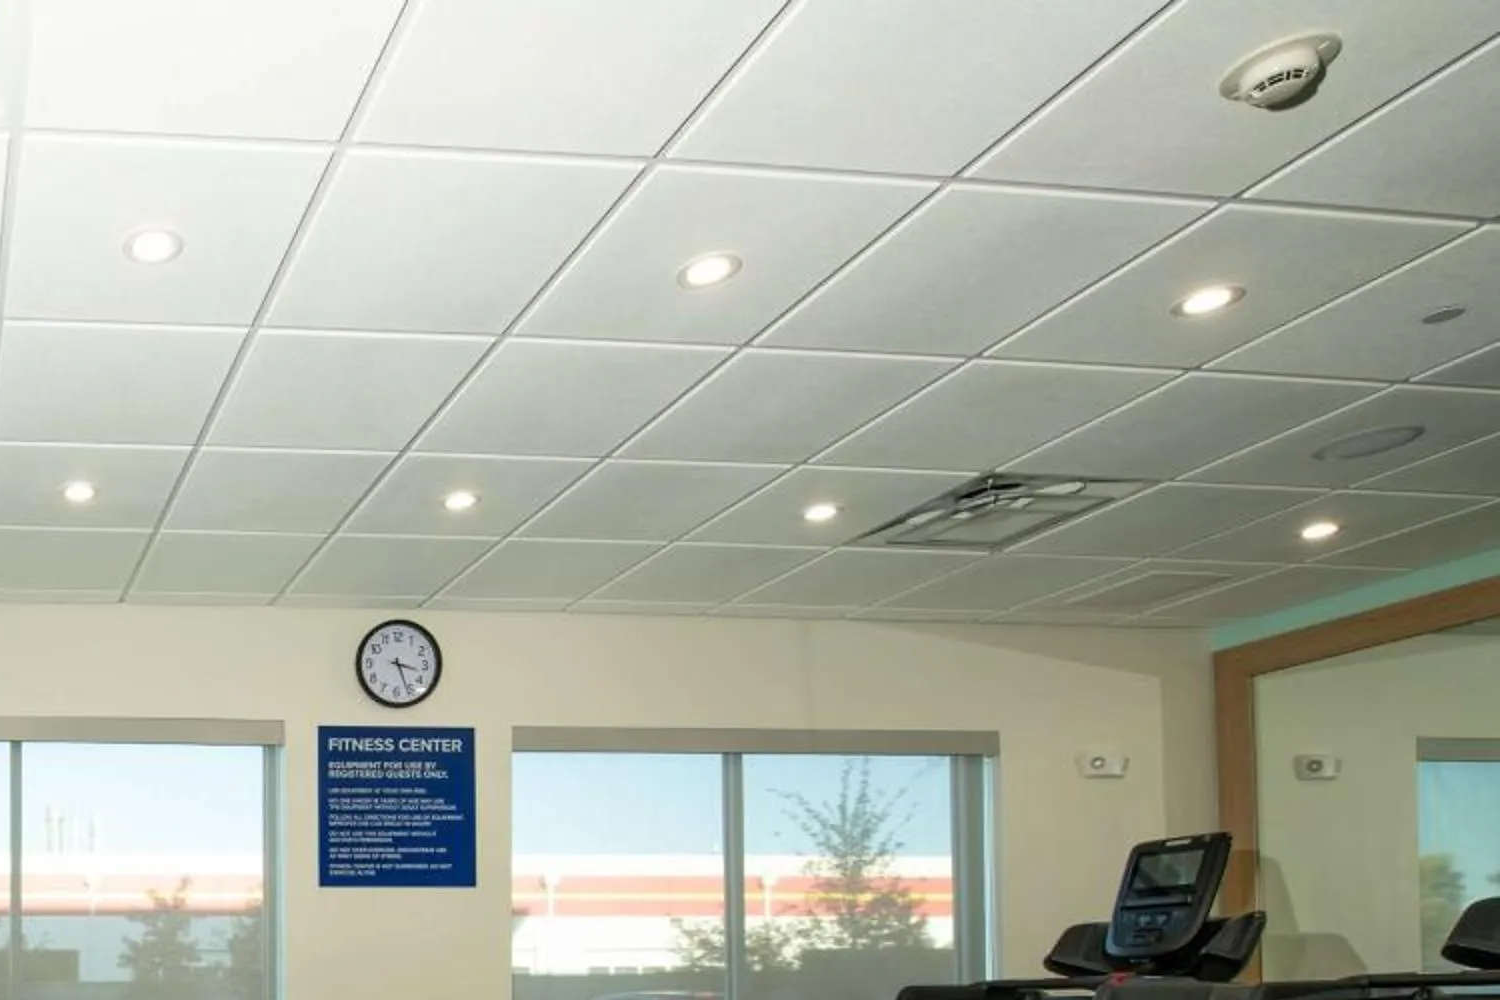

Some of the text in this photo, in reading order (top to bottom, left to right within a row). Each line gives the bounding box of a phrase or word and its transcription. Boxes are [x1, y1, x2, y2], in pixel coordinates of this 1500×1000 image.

[328, 737, 463, 753] FITNESS CENTER
[385, 770, 422, 779] GUESTS
